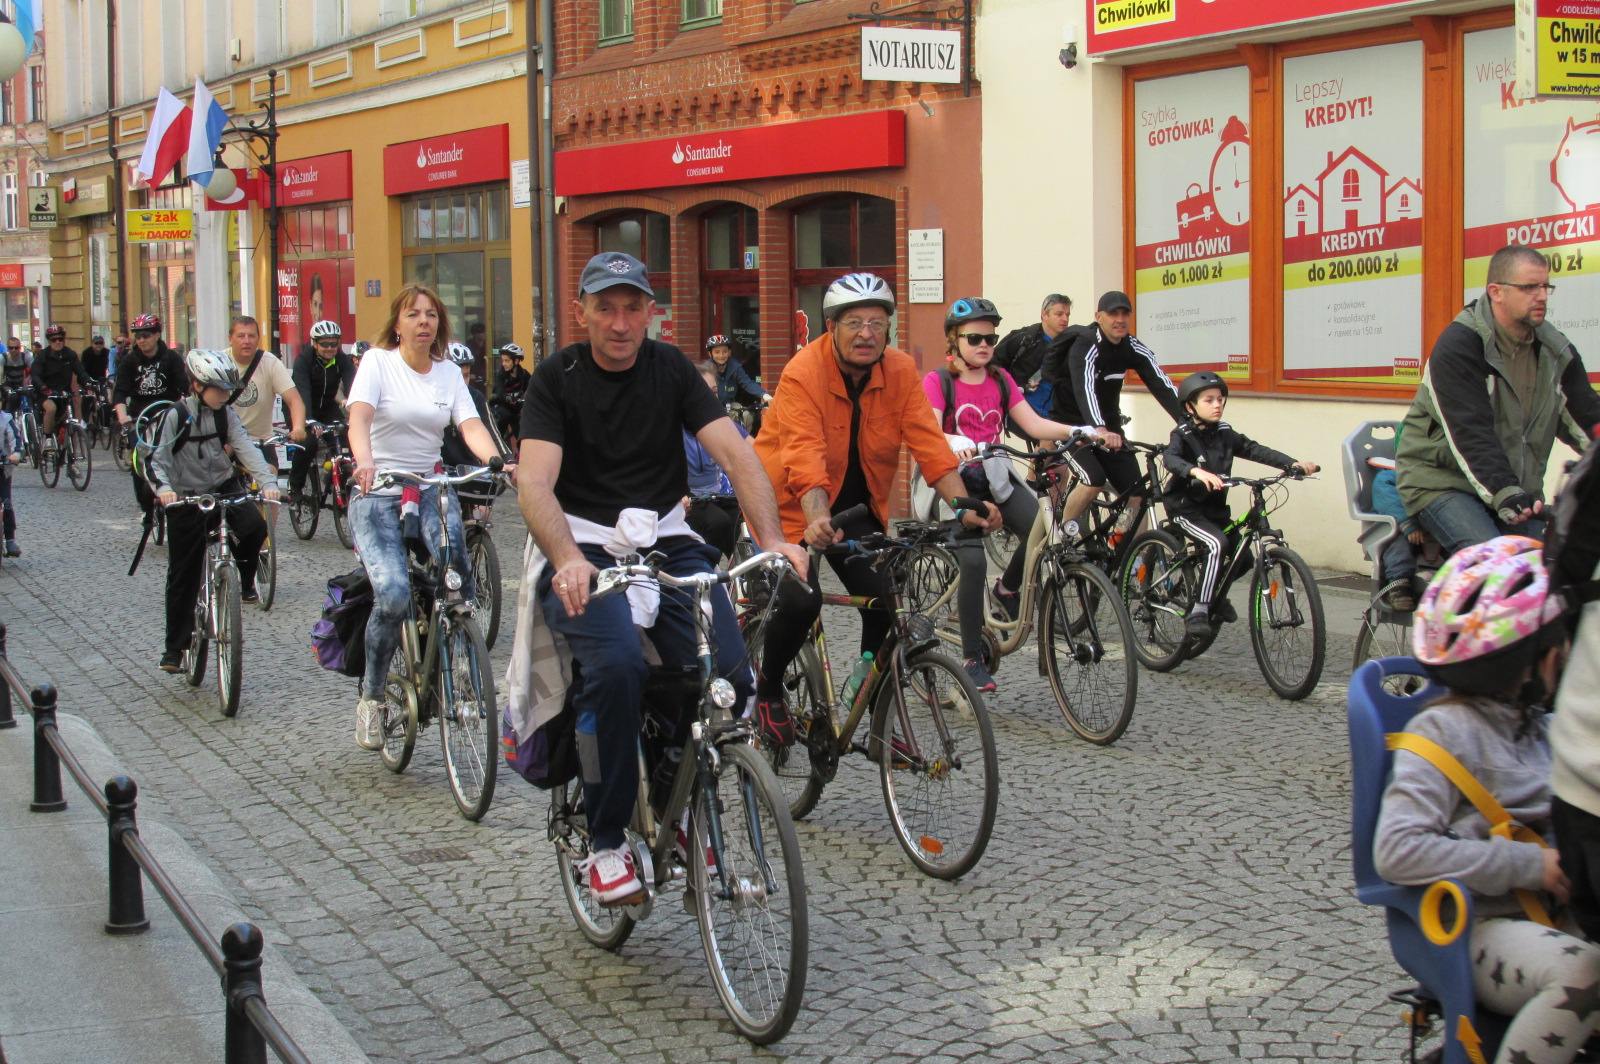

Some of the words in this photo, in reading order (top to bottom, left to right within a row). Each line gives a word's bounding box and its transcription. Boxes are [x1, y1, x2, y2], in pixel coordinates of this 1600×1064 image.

[1098, 0, 1170, 24] Chwilówki
[868, 40, 955, 70] NOTARIUSZ
[1557, 51, 1568, 62] w
[1572, 48, 1587, 63] 15
[1296, 77, 1343, 105] Lepszy
[1142, 105, 1177, 129] Szybka
[1305, 95, 1373, 129] KREDYT!
[1148, 117, 1214, 146] GOTÓWKA!
[427, 141, 464, 166] Santander
[685, 138, 732, 162] Santander
[687, 166, 711, 177] CONSUMER
[711, 165, 724, 175] BANK
[155, 211, 178, 222] żak
[147, 230, 192, 239] DARMO!
[1321, 227, 1385, 253] KREDYTY
[1506, 215, 1595, 246] POŻYCZKI
[1155, 235, 1231, 264] CHWILÓWKI
[1566, 248, 1583, 272] zł
[277, 268, 298, 291] Wejdź
[1162, 269, 1176, 286] do
[1180, 264, 1209, 284] 1.000
[1212, 261, 1223, 279] zł
[1308, 263, 1325, 282] do
[1328, 255, 1382, 280] 200.000
[1385, 252, 1399, 273] zł
